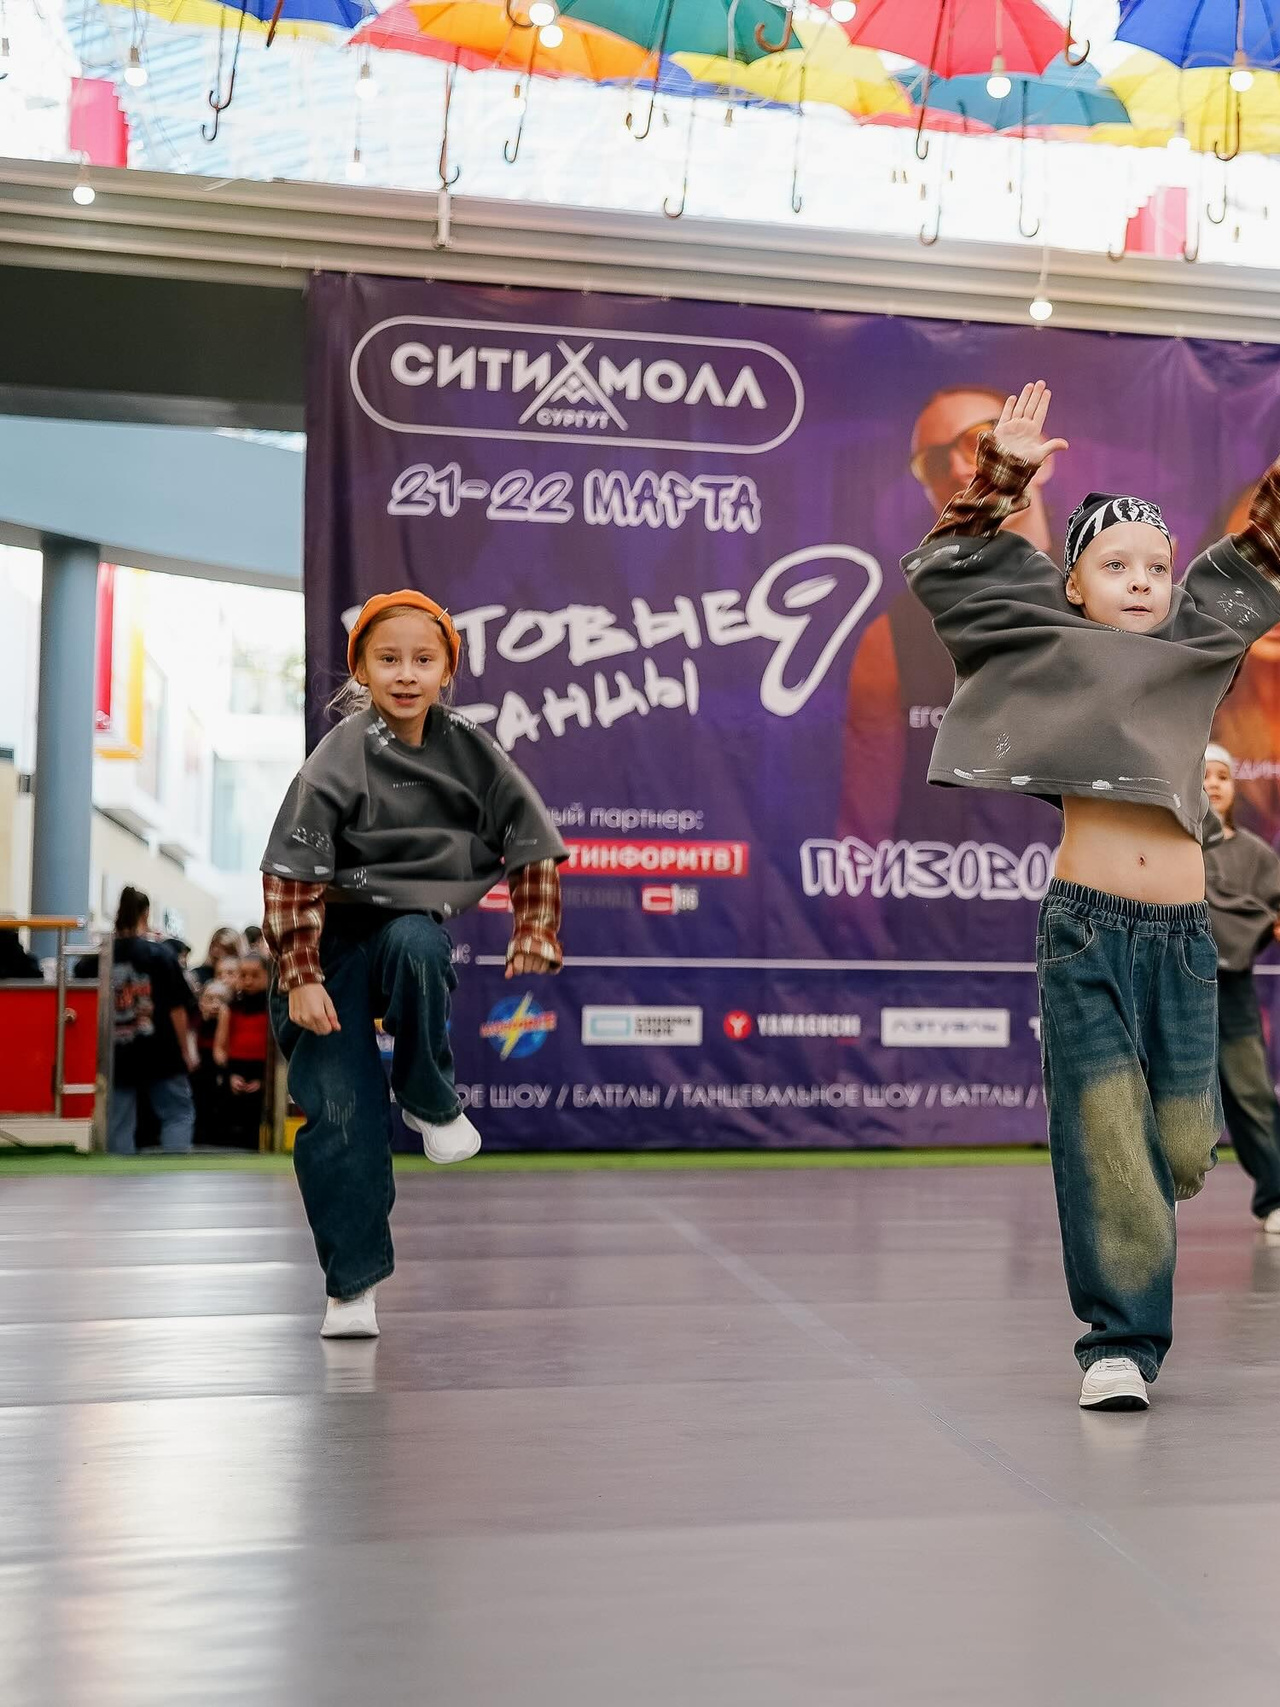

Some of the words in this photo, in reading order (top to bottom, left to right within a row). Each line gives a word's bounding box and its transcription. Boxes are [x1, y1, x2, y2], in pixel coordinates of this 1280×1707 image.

[390, 342, 551, 394] СИТИ
[599, 356, 767, 410] МОЛЛ
[536, 407, 609, 430] СУРГУТ
[387, 462, 574, 524] 21-22
[583, 468, 763, 533] МАРТА
[909, 706, 947, 728] ЕГО
[591, 807, 704, 833] партнер:
[800, 835, 1057, 901] ПРИЗОВО
[490, 1083, 552, 1109] ШОУ
[573, 1083, 660, 1109] БАТТЛЫ
[681, 1083, 861, 1109] ТАНЦЕВАЛЬНОЕ
[863, 1083, 923, 1109] ШОУ
[940, 1083, 1024, 1108] БАТТЛЫ
